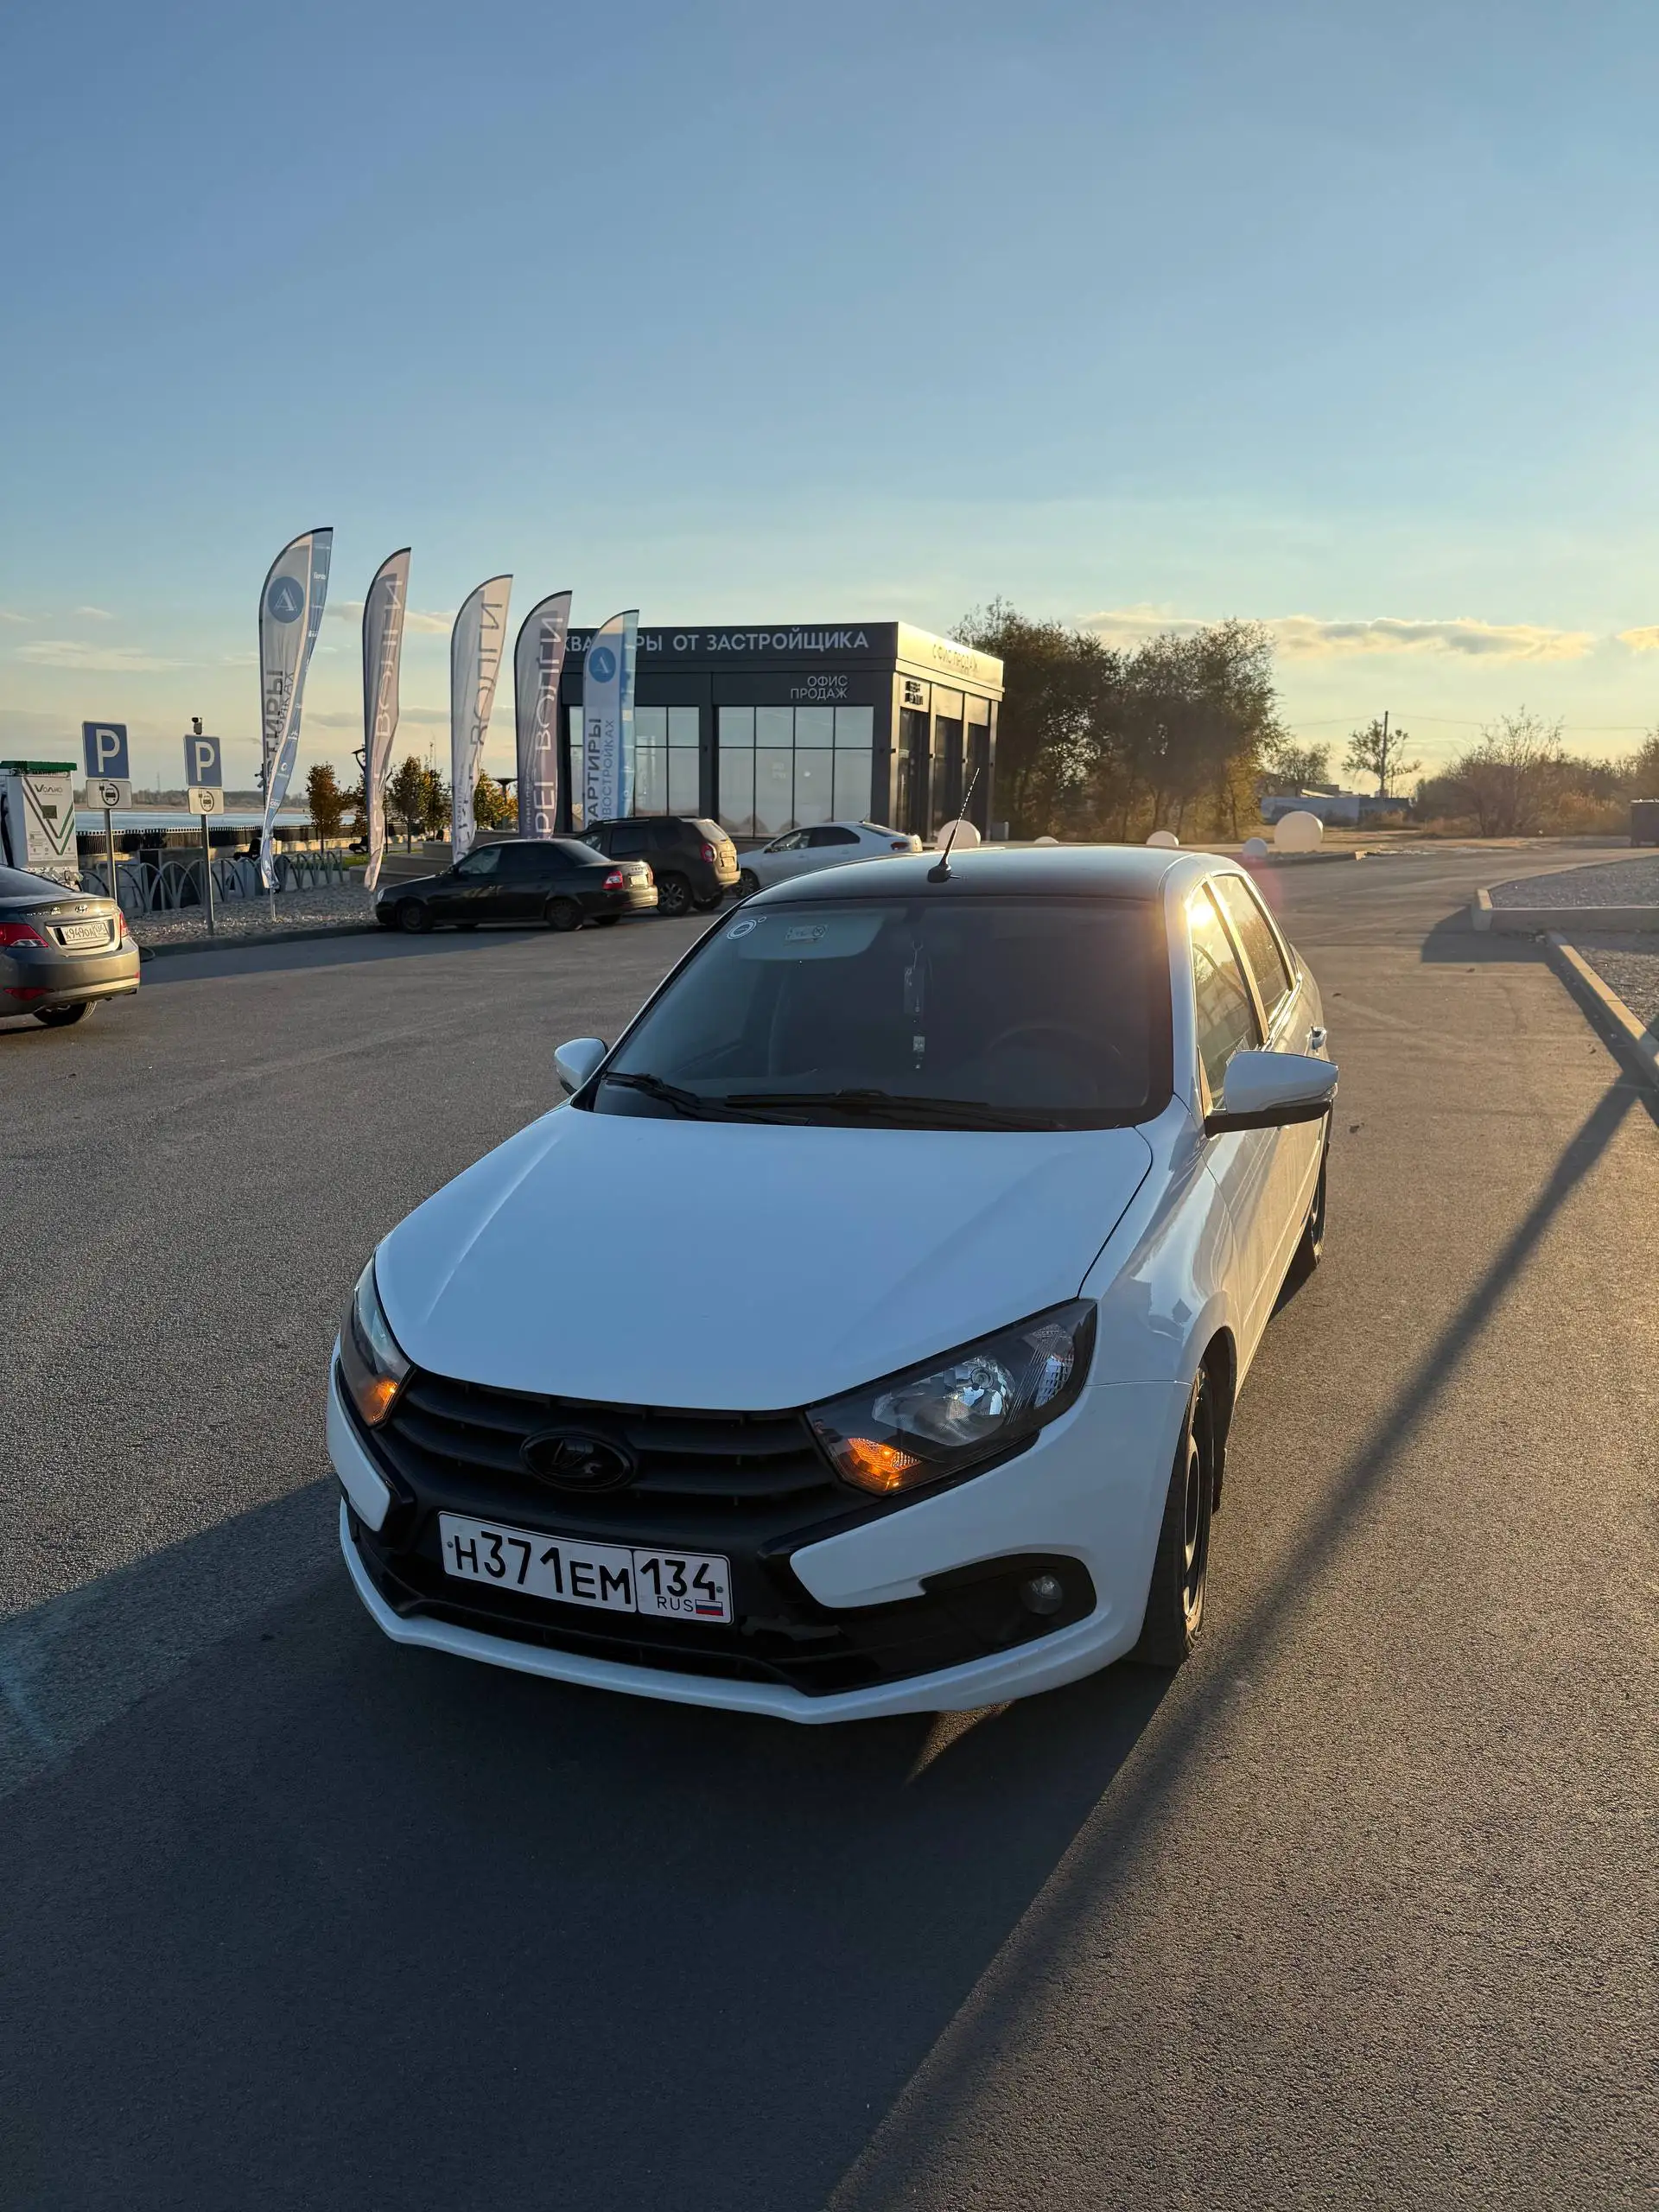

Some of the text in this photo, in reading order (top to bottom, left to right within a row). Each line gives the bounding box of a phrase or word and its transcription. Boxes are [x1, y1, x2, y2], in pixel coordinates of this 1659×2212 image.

[673, 634, 700, 652] ОТ
[707, 627, 869, 652] ЗАСТРОЙЩИКА
[790, 688, 848, 702] ПРОДАЖ
[807, 675, 849, 687] ОФИС
[96, 728, 120, 772] P
[194, 741, 215, 782] P
[588, 718, 601, 824] АРТИРЫ
[454, 1530, 715, 1605] Н371ЕМ 134
[657, 1596, 694, 1613] RUS
